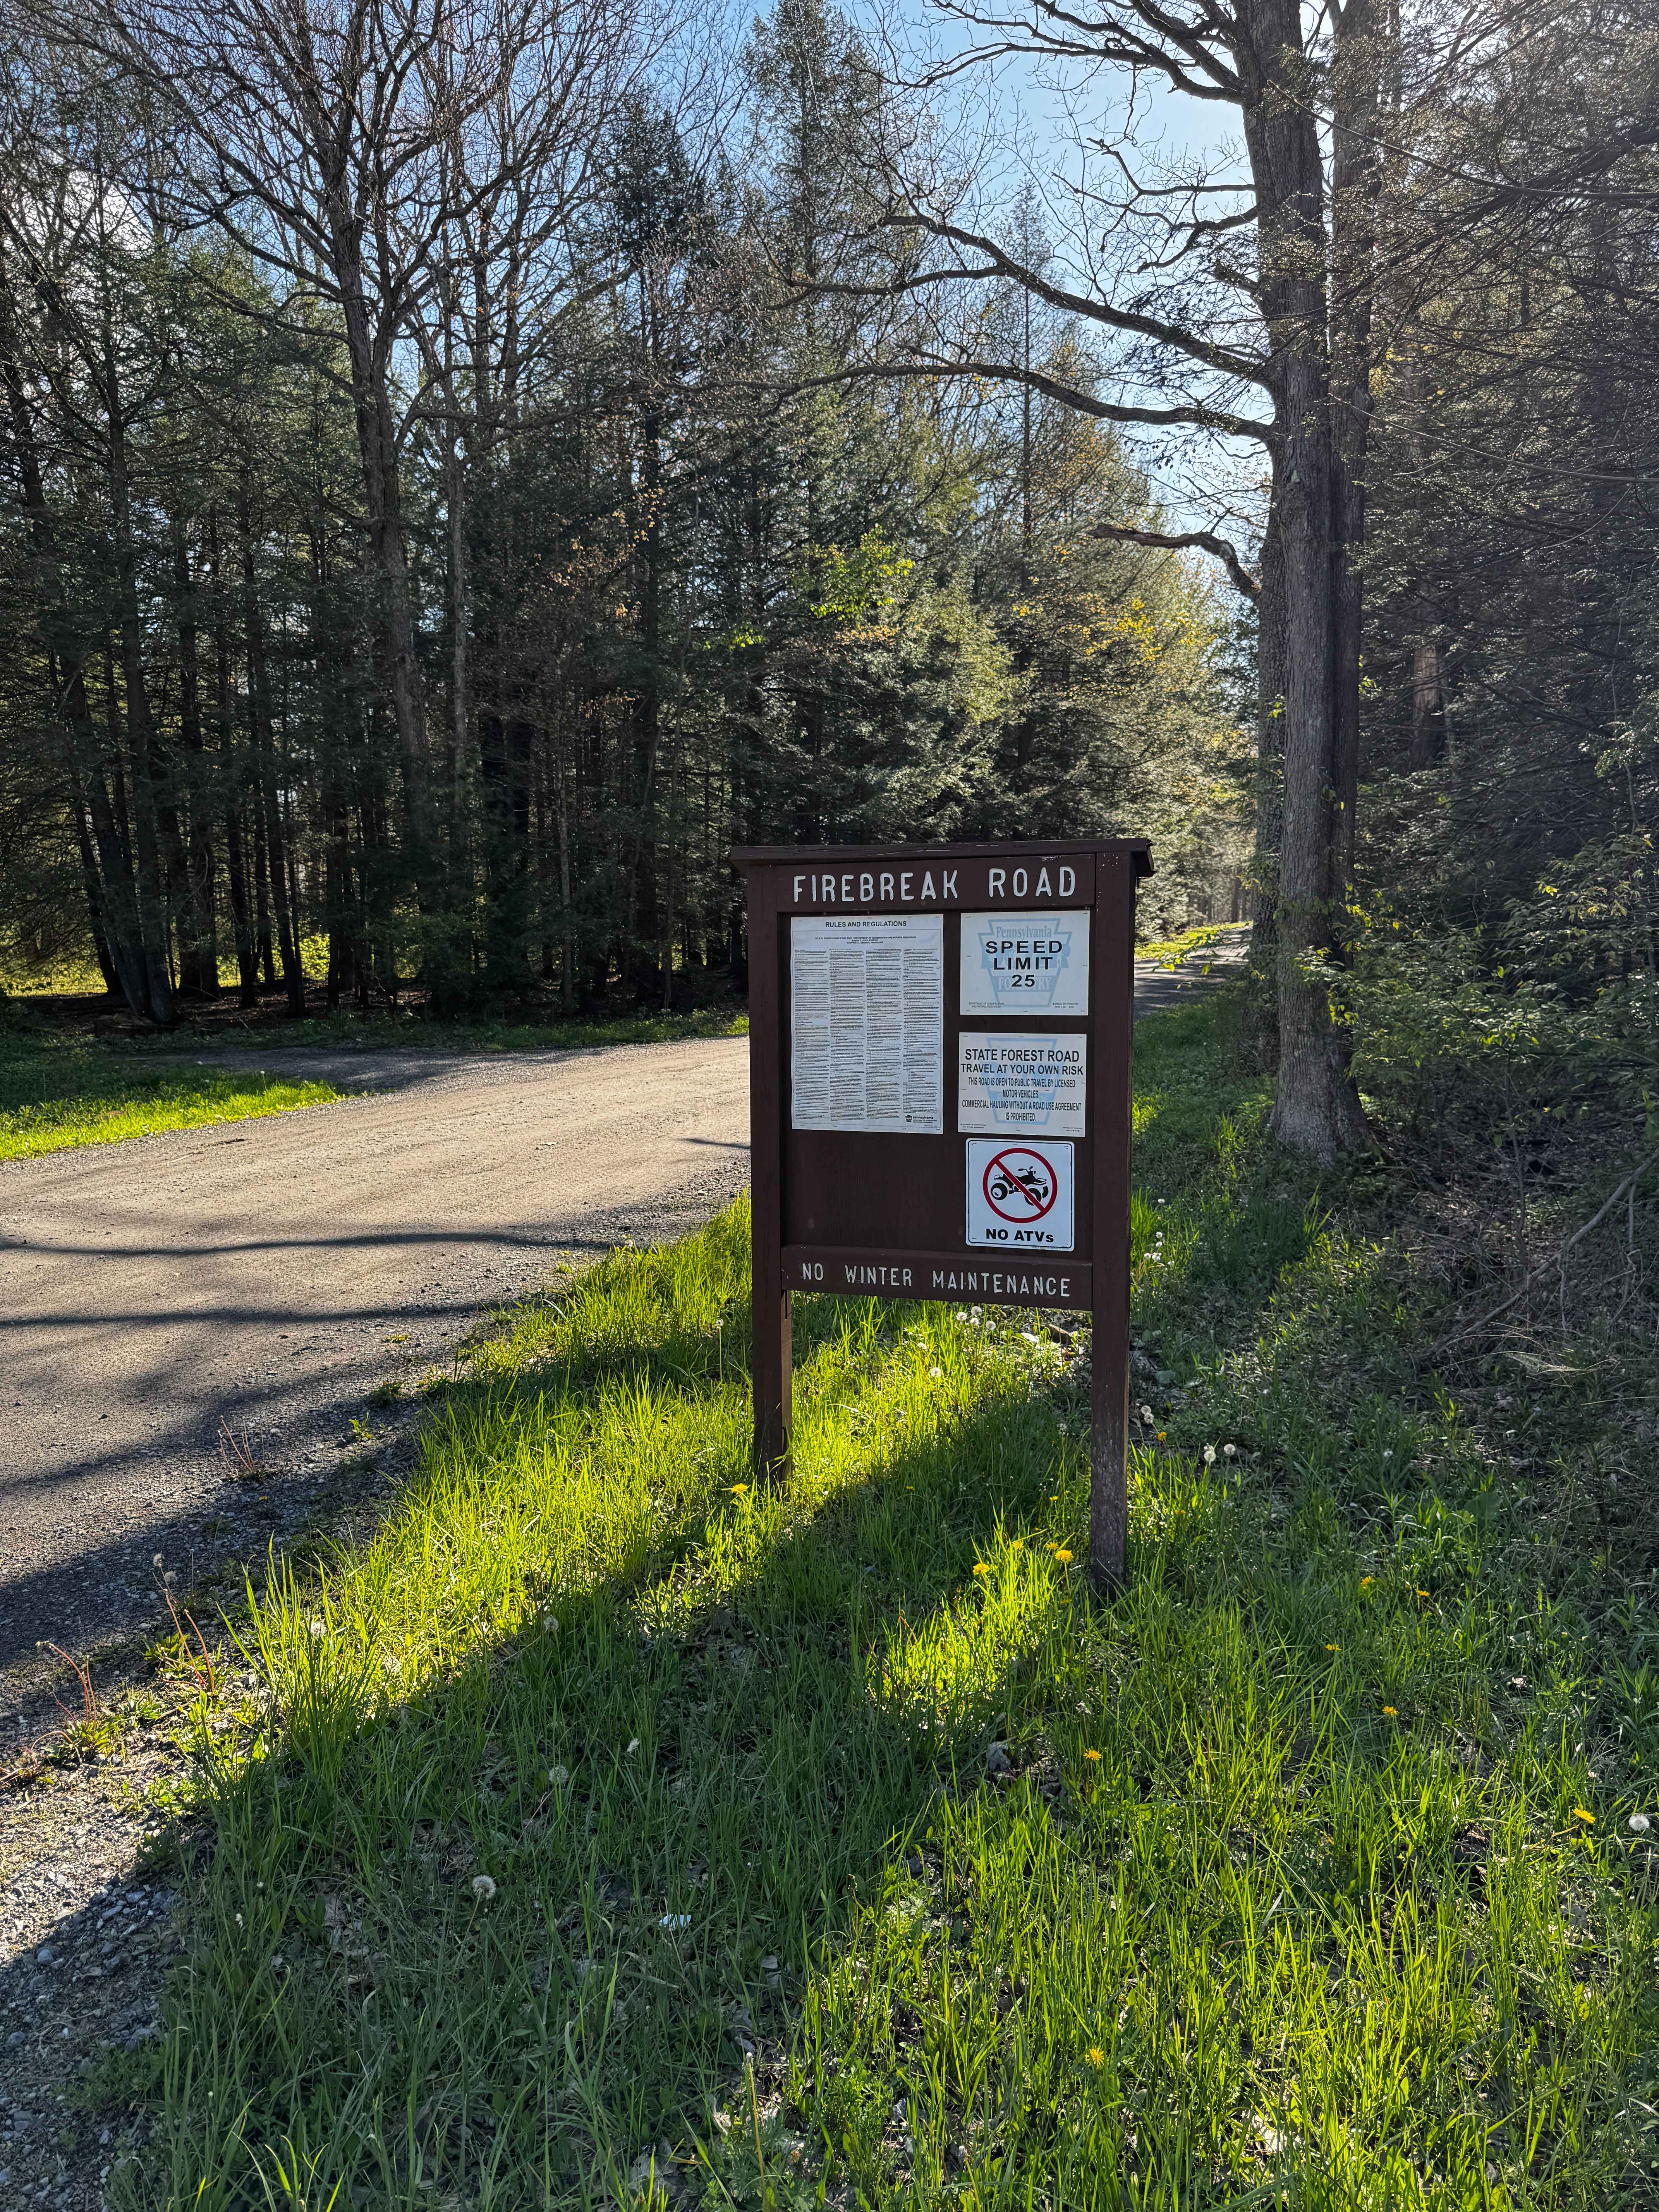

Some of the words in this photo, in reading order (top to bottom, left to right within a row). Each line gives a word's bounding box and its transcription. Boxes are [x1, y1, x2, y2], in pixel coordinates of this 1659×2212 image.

[793, 870, 958, 902] FIREBREAK
[989, 866, 1075, 897] ROAD
[996, 926, 1052, 939] Pennsylvania
[985, 940, 1062, 954] SPEED
[994, 957, 1053, 970] LIMIT
[1011, 974, 1035, 987] 25
[965, 1048, 998, 1060] STATE
[1001, 1049, 1044, 1061] FOREST
[1048, 1050, 1079, 1062] ROAD
[960, 1063, 995, 1073] TRAVEL
[997, 1065, 1008, 1073] AT
[1010, 1065, 1035, 1074] YOUR
[1038, 1065, 1059, 1075] OWN
[1062, 1066, 1084, 1075] RISK
[969, 1077, 977, 1085] THIS
[978, 1077, 990, 1085] ROAD
[996, 1078, 1007, 1086] OPEN
[1008, 1078, 1014, 1086] TO
[1015, 1079, 1030, 1087] PUBLIC
[1031, 1079, 1047, 1087] TRAVEL
[1048, 1079, 1053, 1087] BY
[1054, 1080, 1075, 1088] LICENSED
[1002, 1089, 1017, 1098] MOTOR
[962, 1100, 989, 1109] COMMERCIAL
[990, 1101, 1008, 1109] HAULING
[1009, 1101, 1028, 1109] WITHOUT
[1046, 1102, 1054, 1110] USE
[1055, 1103, 1082, 1111] AGREEMENT
[1005, 1112, 1009, 1120] IS
[986, 1228, 1008, 1240] NO
[1014, 1230, 1054, 1243] ATVs
[802, 1263, 823, 1280] NO
[845, 1265, 912, 1286] WINTER
[933, 1270, 1070, 1297] MAINTENANCE
